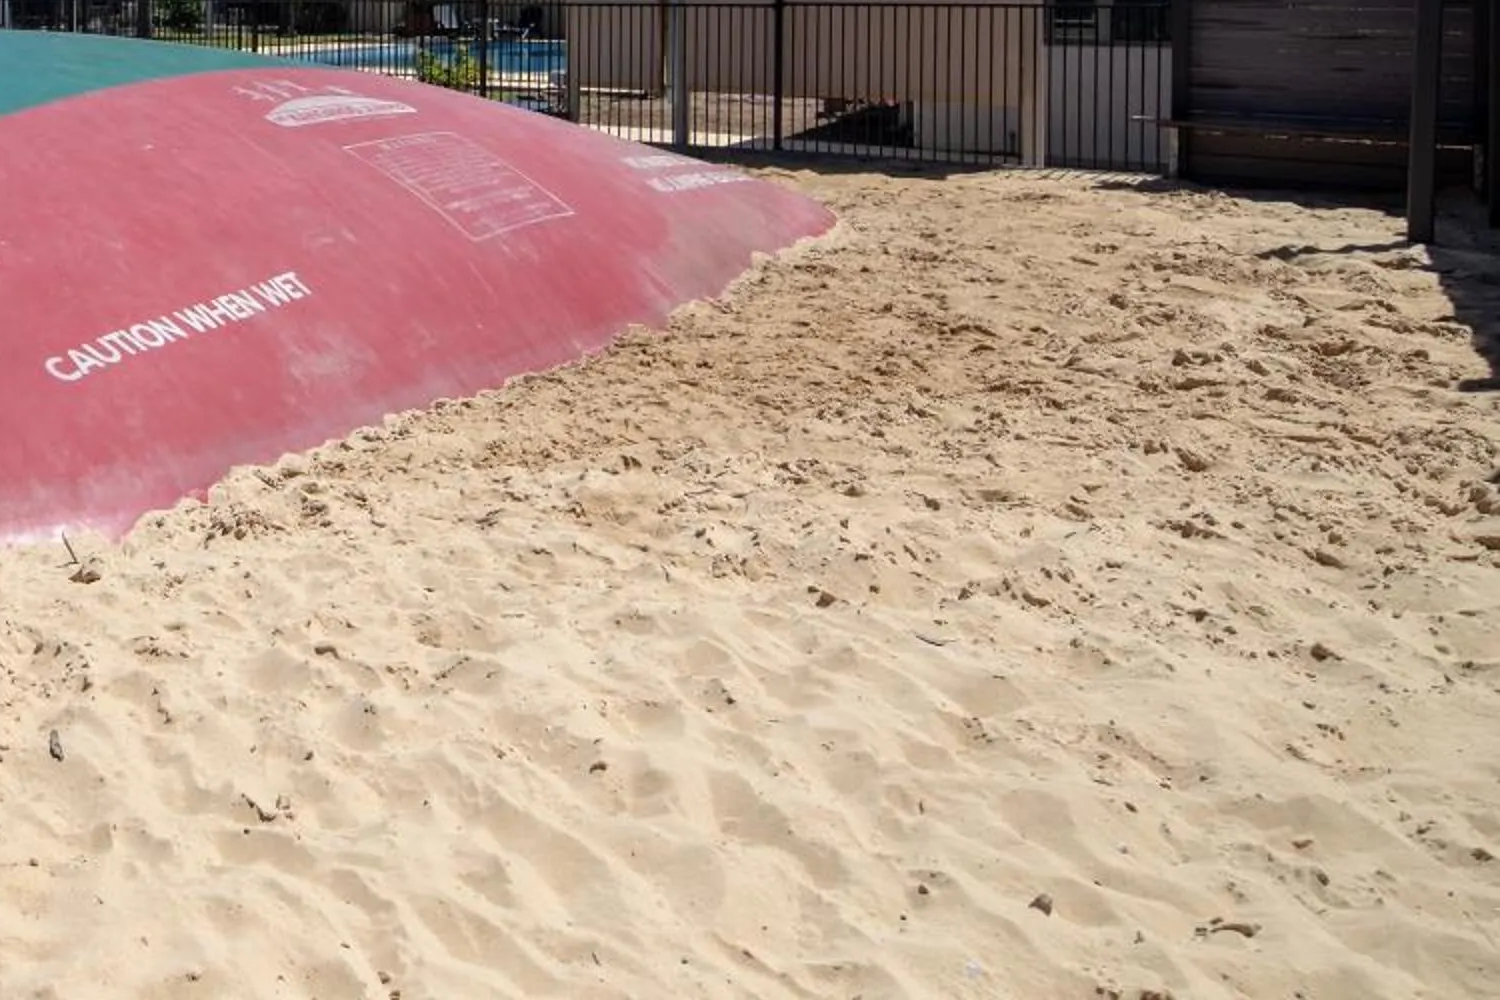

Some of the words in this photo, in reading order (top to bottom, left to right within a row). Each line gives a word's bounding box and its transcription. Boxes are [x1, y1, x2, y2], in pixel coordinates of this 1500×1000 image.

[45, 315, 189, 381] CAUTION
[172, 289, 266, 332] WHEN
[251, 271, 311, 307] WET
